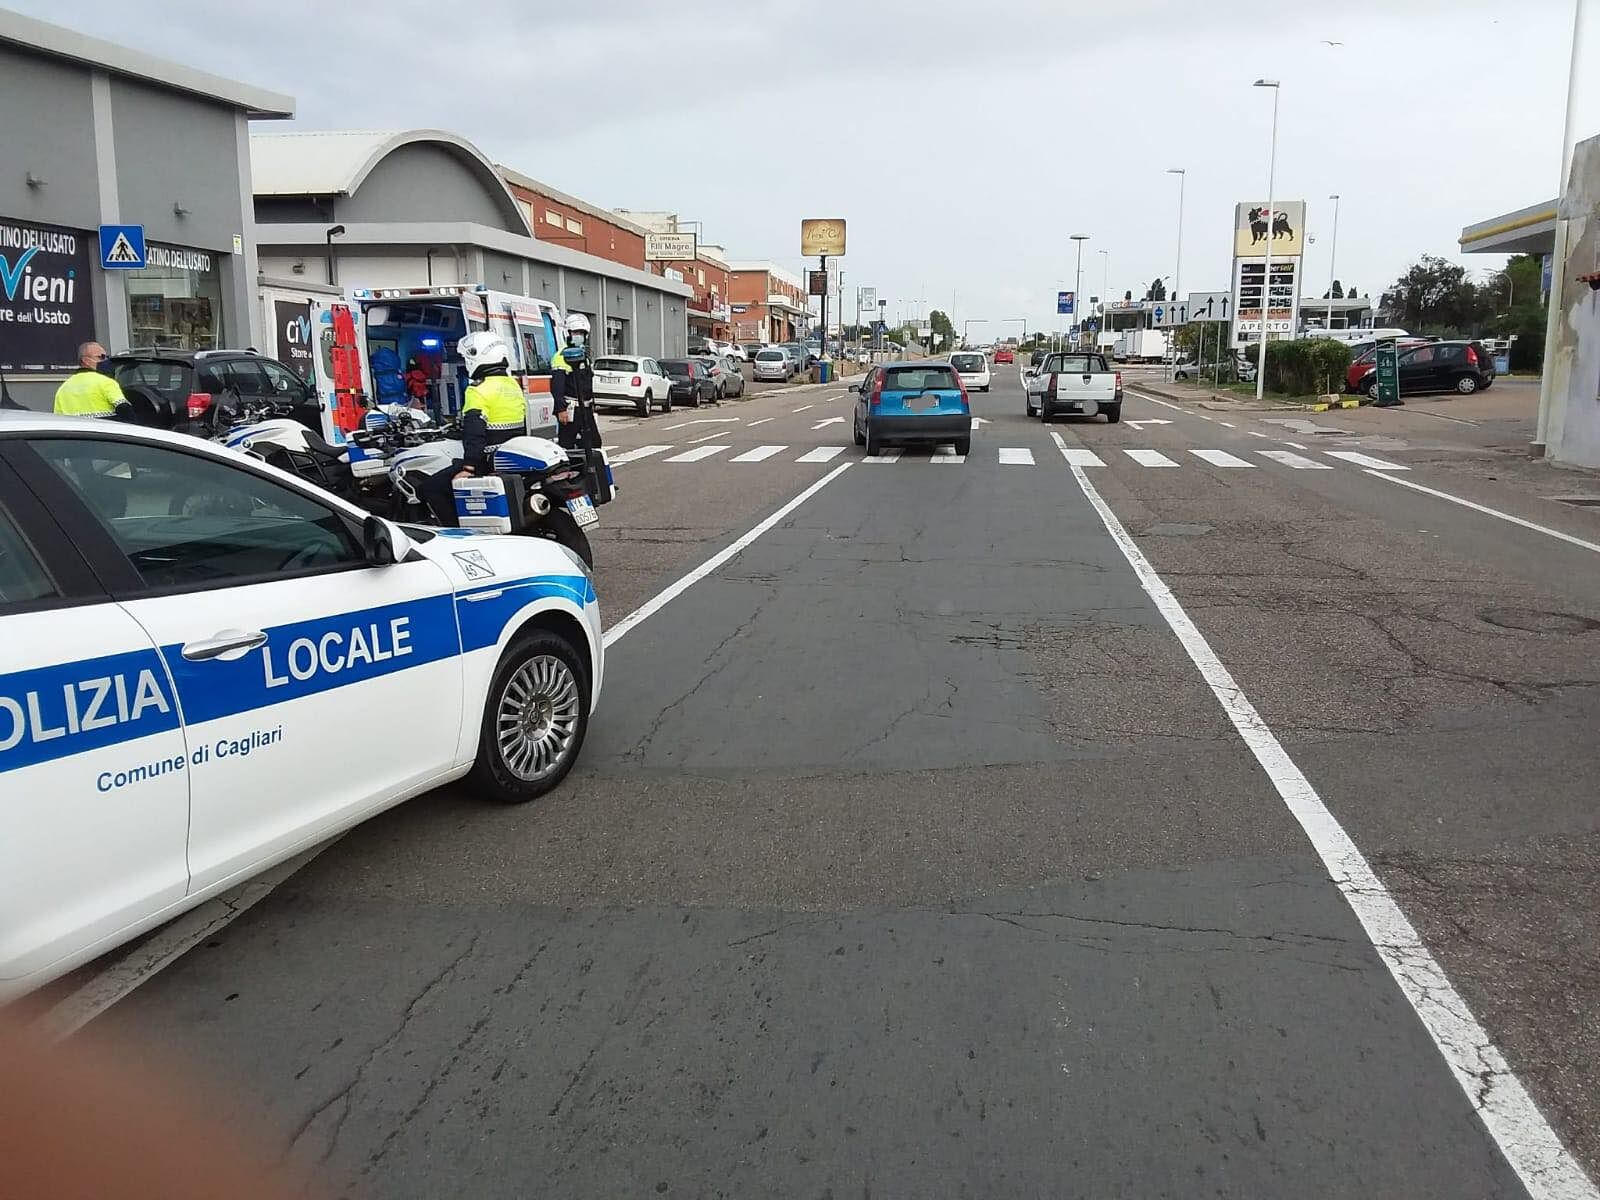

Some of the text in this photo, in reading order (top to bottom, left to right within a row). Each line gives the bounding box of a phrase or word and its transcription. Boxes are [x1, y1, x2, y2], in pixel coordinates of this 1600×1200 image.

[22, 228, 76, 255] DELL'USATO
[170, 249, 211, 272] DELL'USATO
[34, 307, 71, 325] Usato
[1240, 322, 1289, 330] APERTO
[0, 616, 413, 752] OLIZIA LOCALE
[97, 725, 282, 792] Comune di Cagliari
